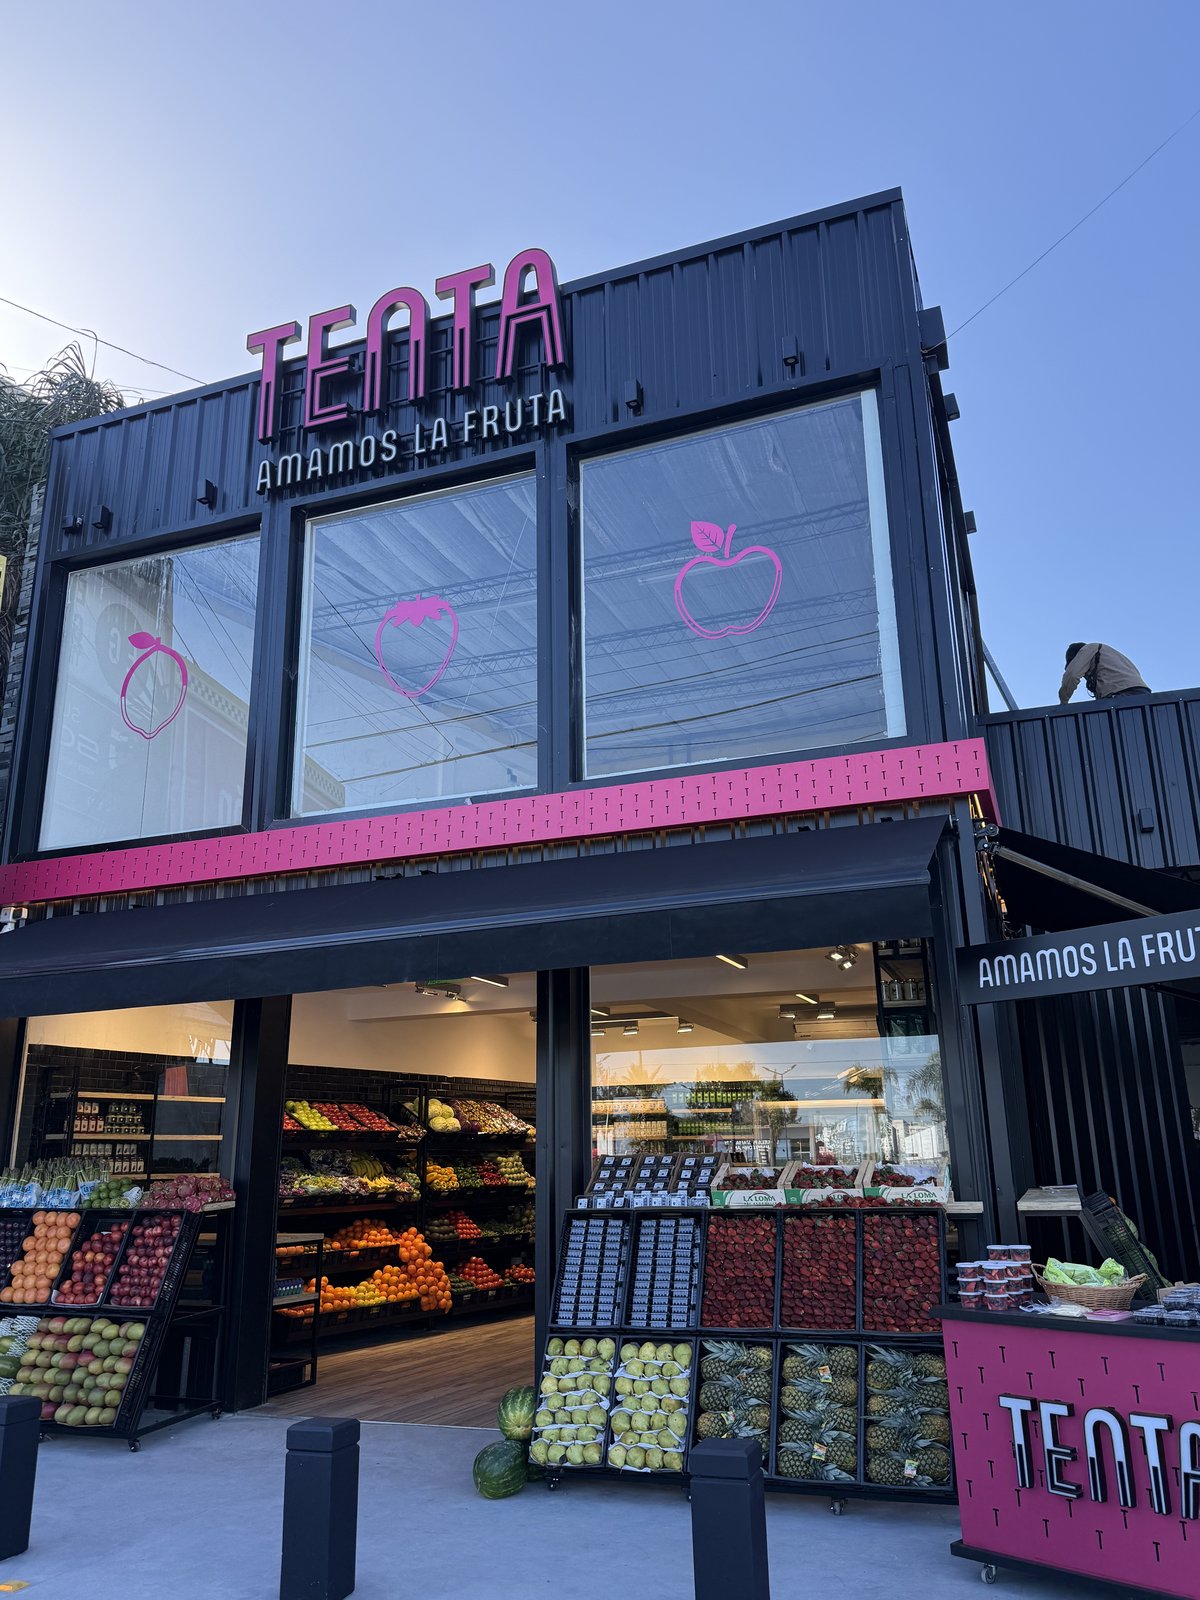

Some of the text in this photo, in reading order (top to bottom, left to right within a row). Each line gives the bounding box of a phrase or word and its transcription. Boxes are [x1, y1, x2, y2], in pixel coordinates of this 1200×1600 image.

[247, 247, 567, 444] TENTA
[256, 389, 566, 493] AMAMOS LA FRUTA
[978, 943, 1097, 988] AMAMOS
[1103, 937, 1135, 972] LA
